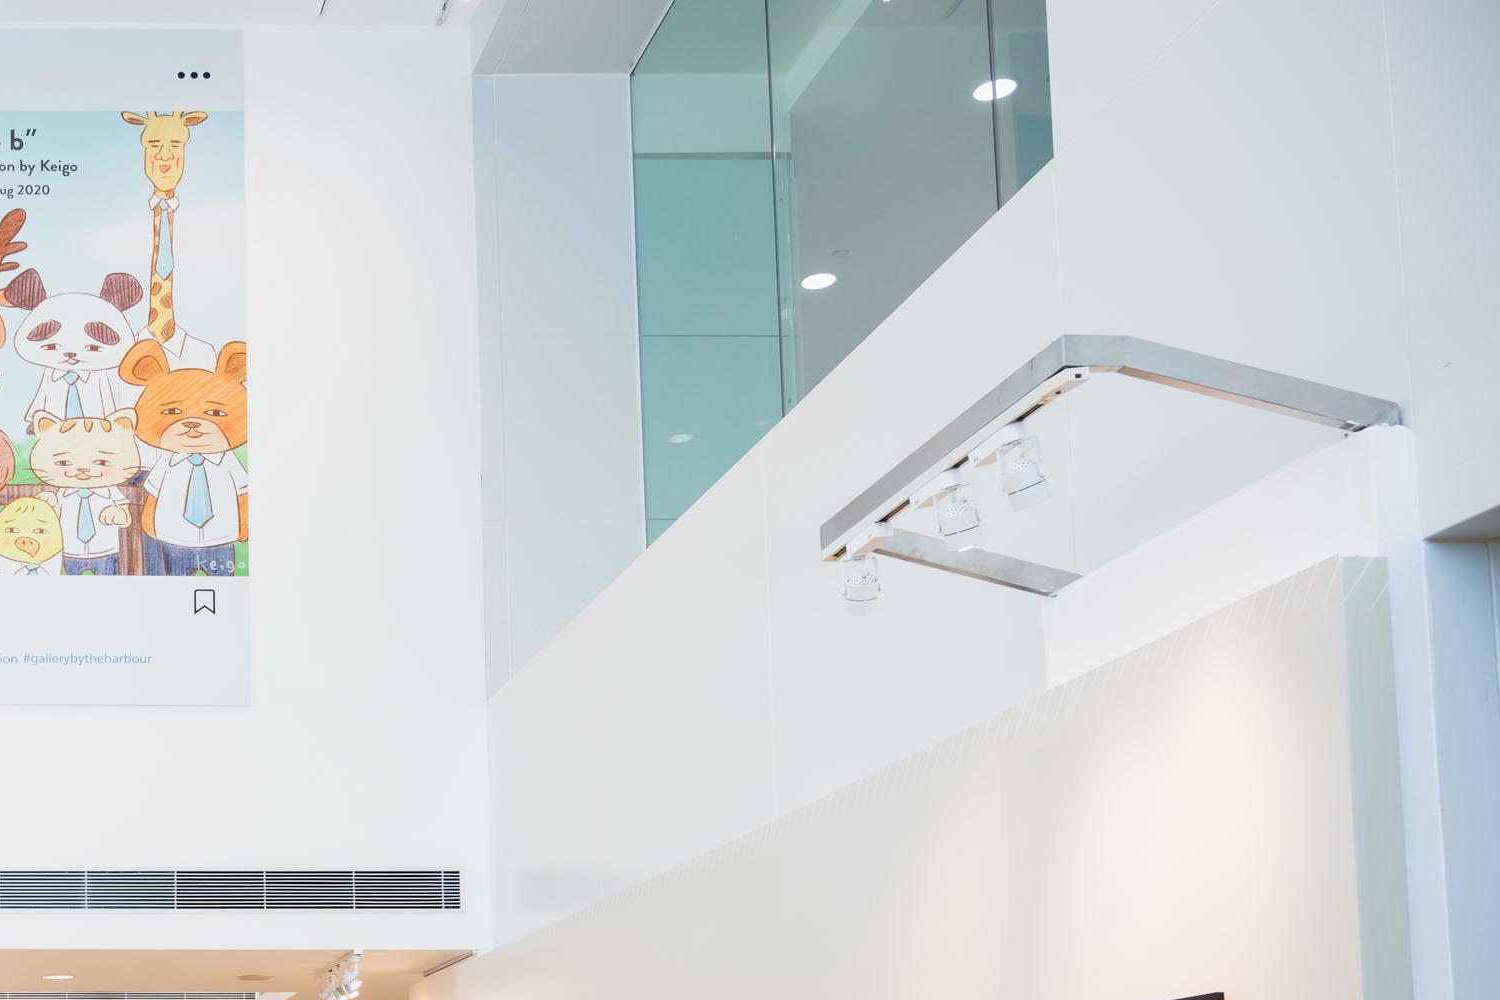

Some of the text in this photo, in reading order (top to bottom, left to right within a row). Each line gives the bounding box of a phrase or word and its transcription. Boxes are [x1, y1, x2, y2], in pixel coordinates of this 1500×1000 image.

[19, 159, 36, 177] by
[40, 159, 78, 177] Keigo
[17, 184, 51, 196] 2020
[23, 652, 152, 667] #gallerybytheharbour
